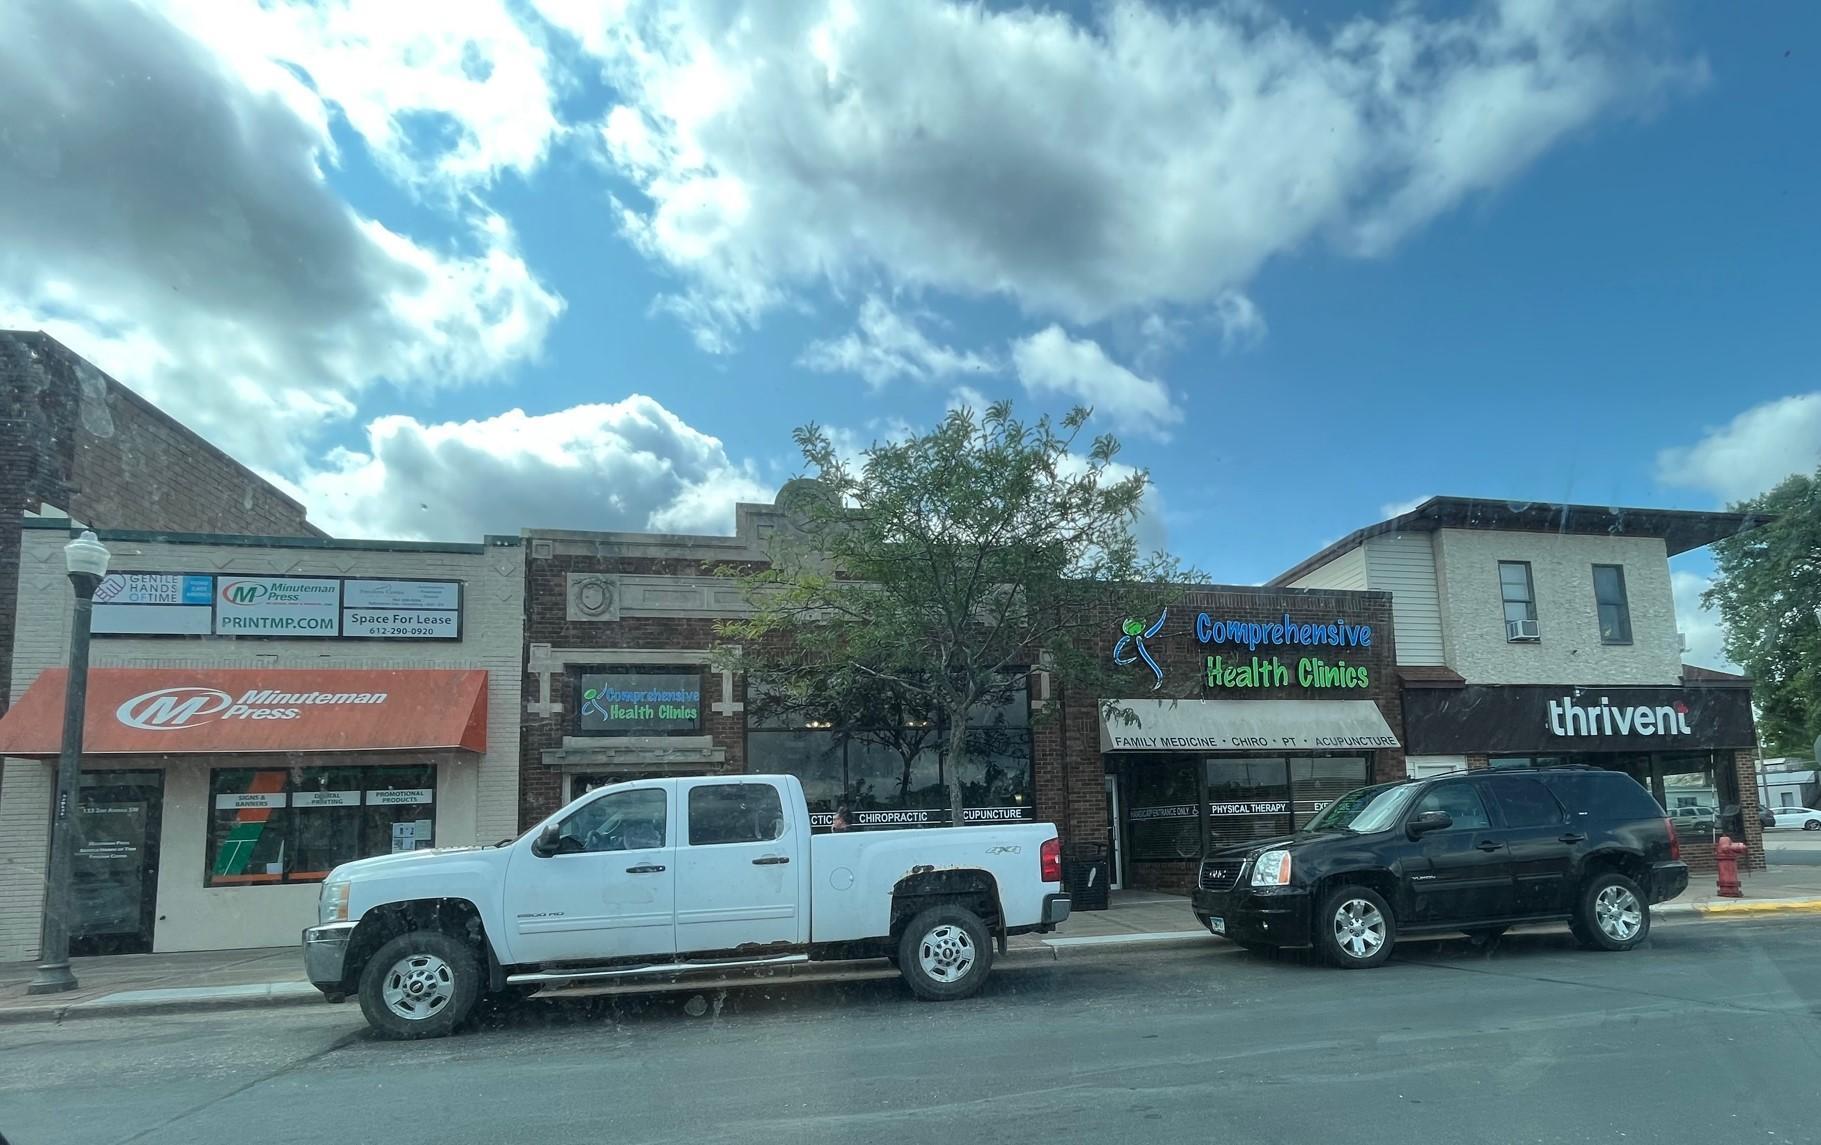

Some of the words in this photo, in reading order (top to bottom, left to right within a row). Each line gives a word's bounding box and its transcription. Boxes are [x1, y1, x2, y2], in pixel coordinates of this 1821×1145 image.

[130, 575, 178, 584] GENTLE
[130, 584, 177, 593] HANDS
[270, 583, 336, 593] Minuteman
[267, 592, 300, 601] Press
[222, 616, 334, 629] PRINTMP.COM
[351, 613, 389, 625] Space
[393, 614, 413, 623] For
[417, 614, 452, 624] Lease
[369, 627, 434, 635] 612-290-0920
[1197, 612, 1372, 651] Comprehensive
[1207, 655, 1289, 688] Health
[1298, 657, 1369, 688] Clinics
[236, 690, 388, 705] Minuteman
[606, 687, 700, 704] Comprehensive
[221, 705, 300, 720] Press
[610, 703, 654, 719] Health
[659, 704, 698, 719] Clinics
[1549, 696, 1692, 736] thrivent
[1115, 736, 1157, 747] FAMILY
[1161, 736, 1217, 747] MEDICINE
[1231, 736, 1268, 746] CHIRO
[1282, 736, 1297, 746] PT
[1315, 736, 1397, 746] ACUPUNCTURE
[1212, 804, 1250, 814] PHYSICAL
[1251, 803, 1286, 812] THERAPY
[811, 814, 833, 825] CTIC
[859, 811, 928, 823] CHIROPRACTIC
[963, 809, 1022, 820] CUPUNCTURE
